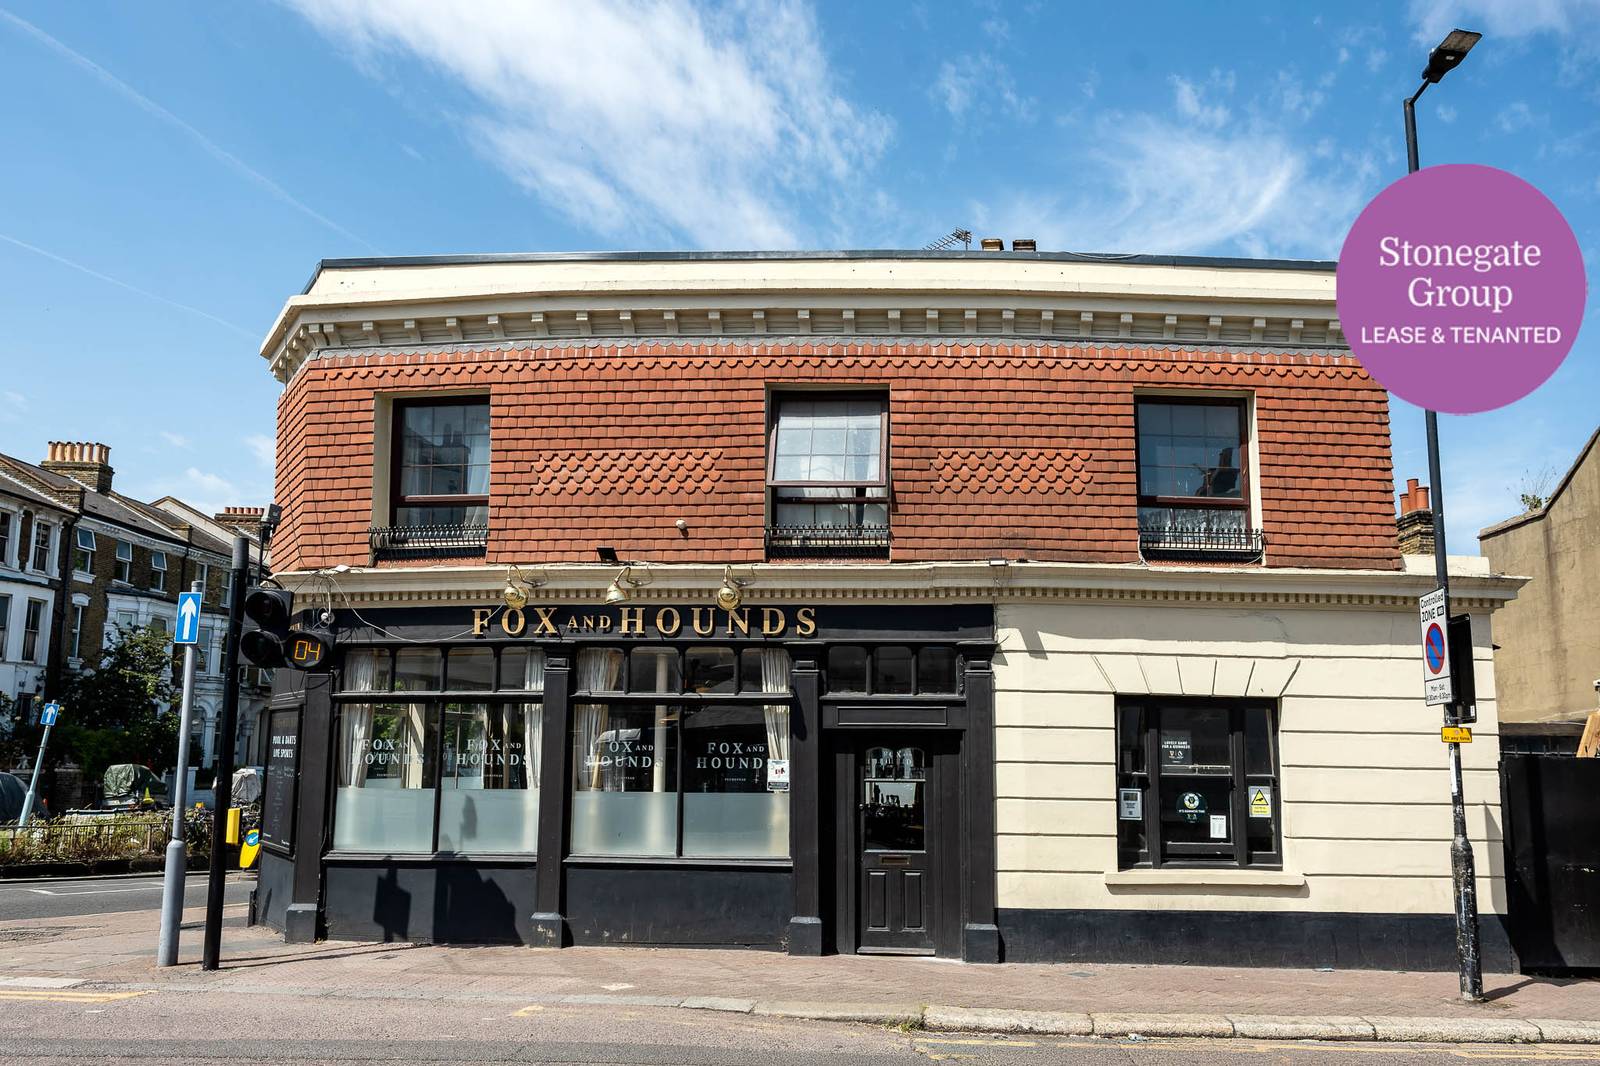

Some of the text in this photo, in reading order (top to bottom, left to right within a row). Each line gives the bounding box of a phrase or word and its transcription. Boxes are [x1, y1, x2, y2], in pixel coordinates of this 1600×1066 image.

[1421, 592, 1443, 609] Controlled
[1422, 608, 1435, 622] ZONE
[471, 607, 816, 636] FOX AND HOUNDS
[294, 640, 321, 661] 04
[285, 735, 297, 745] DARTS
[361, 739, 395, 751] FOX
[467, 739, 501, 751] FOX
[280, 748, 294, 758] SPORTS
[608, 741, 633, 753] OX
[707, 742, 743, 754] FOX
[696, 757, 763, 769] HOUND
